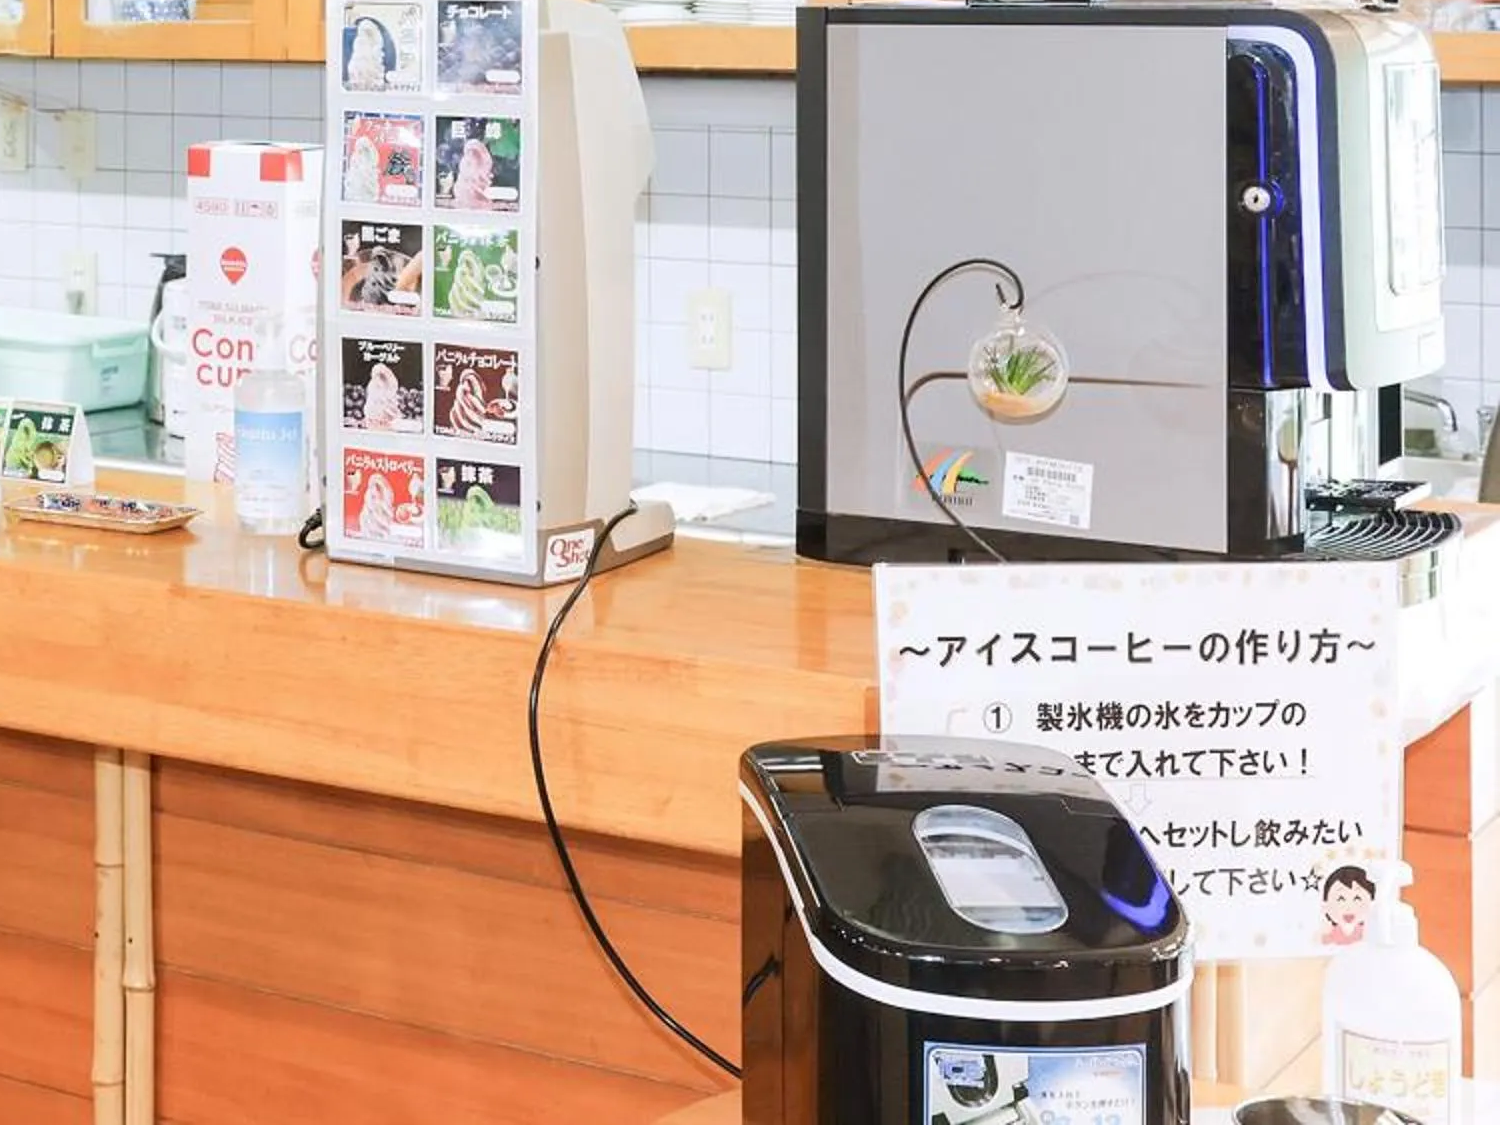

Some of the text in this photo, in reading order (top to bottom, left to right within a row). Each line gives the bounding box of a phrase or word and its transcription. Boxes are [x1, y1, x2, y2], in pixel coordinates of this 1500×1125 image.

[446, 5, 513, 21] チョコレート
[1036, 698, 1308, 733] 製氷機の氷をカップの
